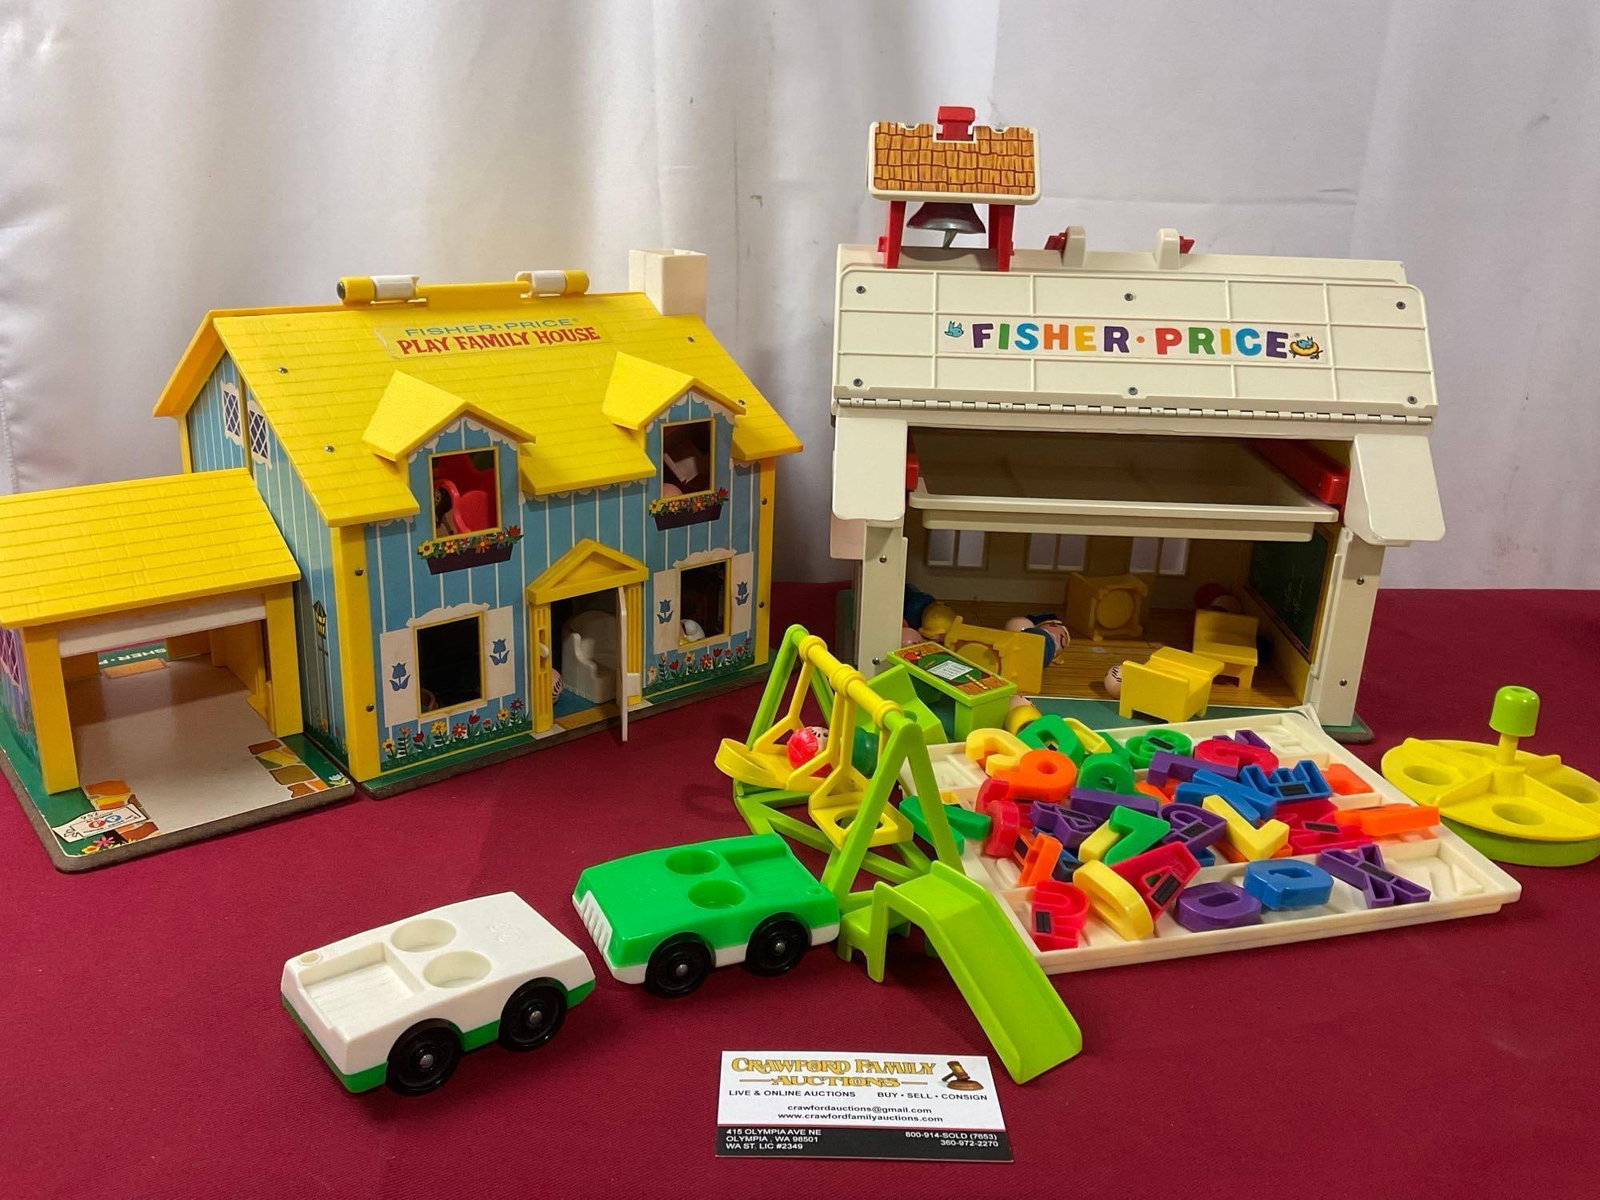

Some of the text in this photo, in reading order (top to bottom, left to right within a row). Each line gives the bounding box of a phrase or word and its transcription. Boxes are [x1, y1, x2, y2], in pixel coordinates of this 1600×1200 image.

[397, 326, 601, 354] PLAY FAMILY HOUSE
[731, 1057, 937, 1076] CRAWFORD FAMILY
[770, 1075, 901, 1088] AUCTIONS
[803, 1090, 856, 1098] AUCTIONS
[787, 1104, 932, 1114] crawfordauctions@gmail.com
[777, 1113, 944, 1123] www.crawfordfamilyauctions.com
[905, 1131, 968, 1139] 800-914-SOLD
